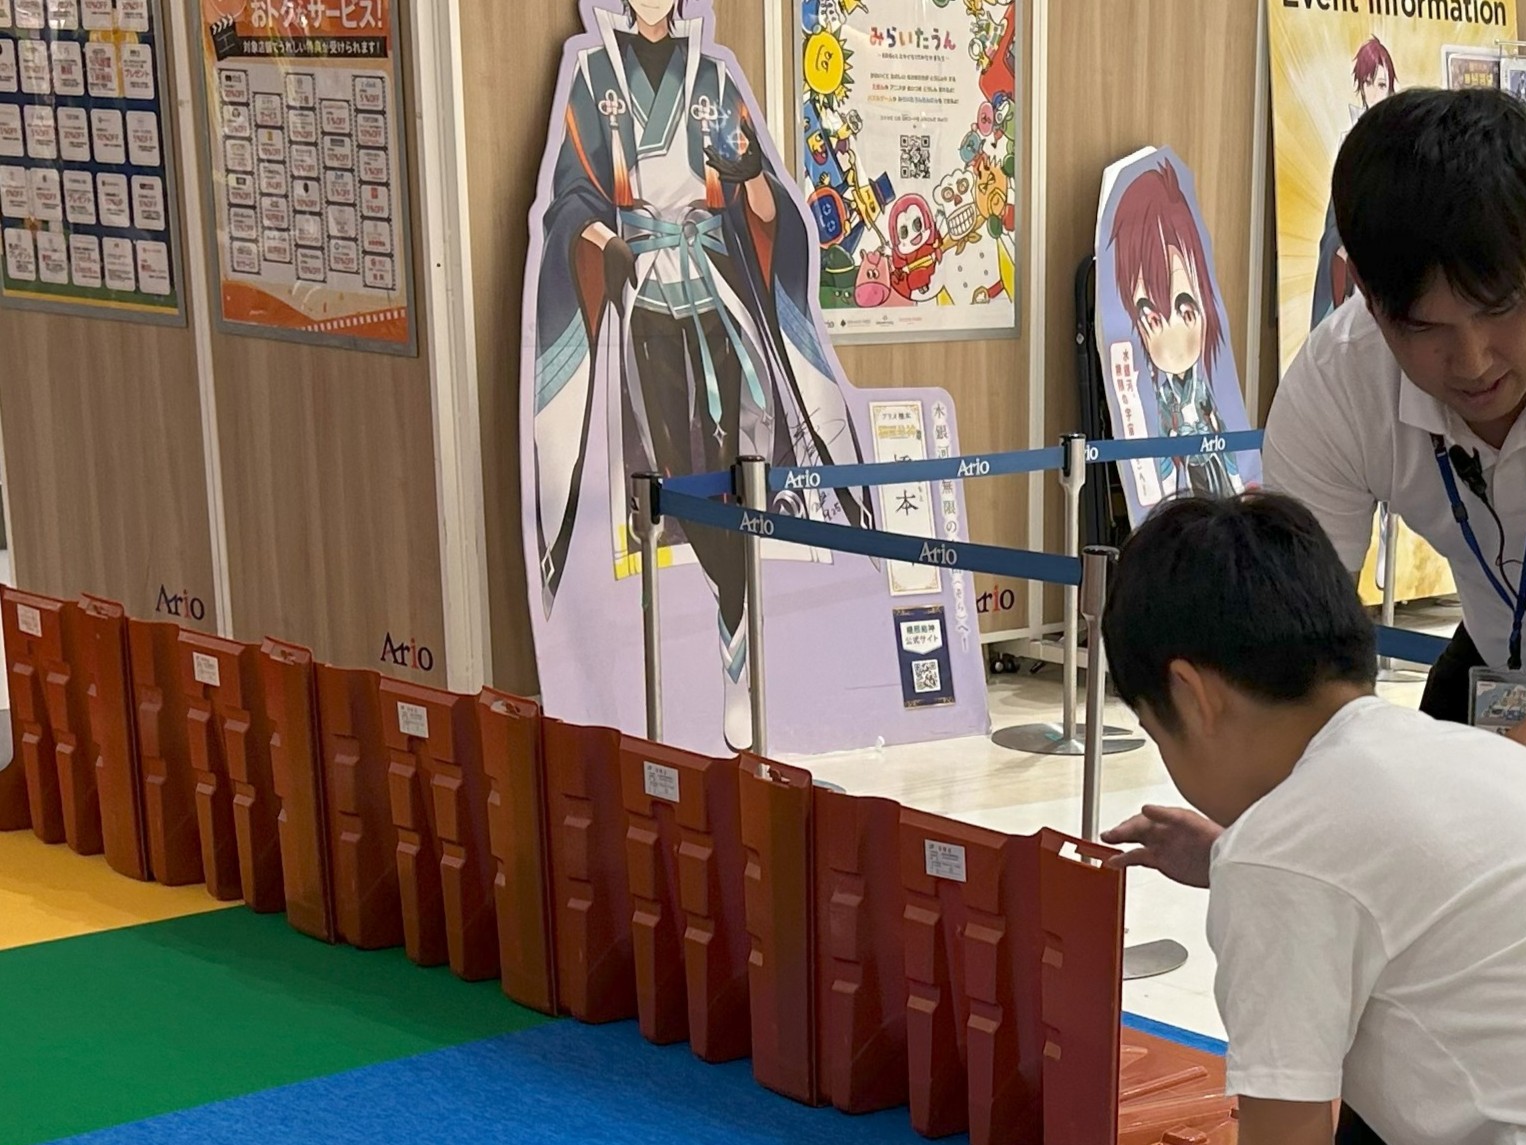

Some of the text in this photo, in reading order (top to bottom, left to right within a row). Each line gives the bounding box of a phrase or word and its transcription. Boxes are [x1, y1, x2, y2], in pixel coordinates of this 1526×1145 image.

[870, 27, 956, 51] みらいたうん
[1200, 435, 1225, 453] Ario
[784, 469, 821, 489] Ario
[957, 457, 990, 477] Ario
[739, 511, 774, 536] Ario
[918, 541, 958, 565] Ario
[155, 584, 205, 621] Ario
[380, 631, 433, 671] Ario
